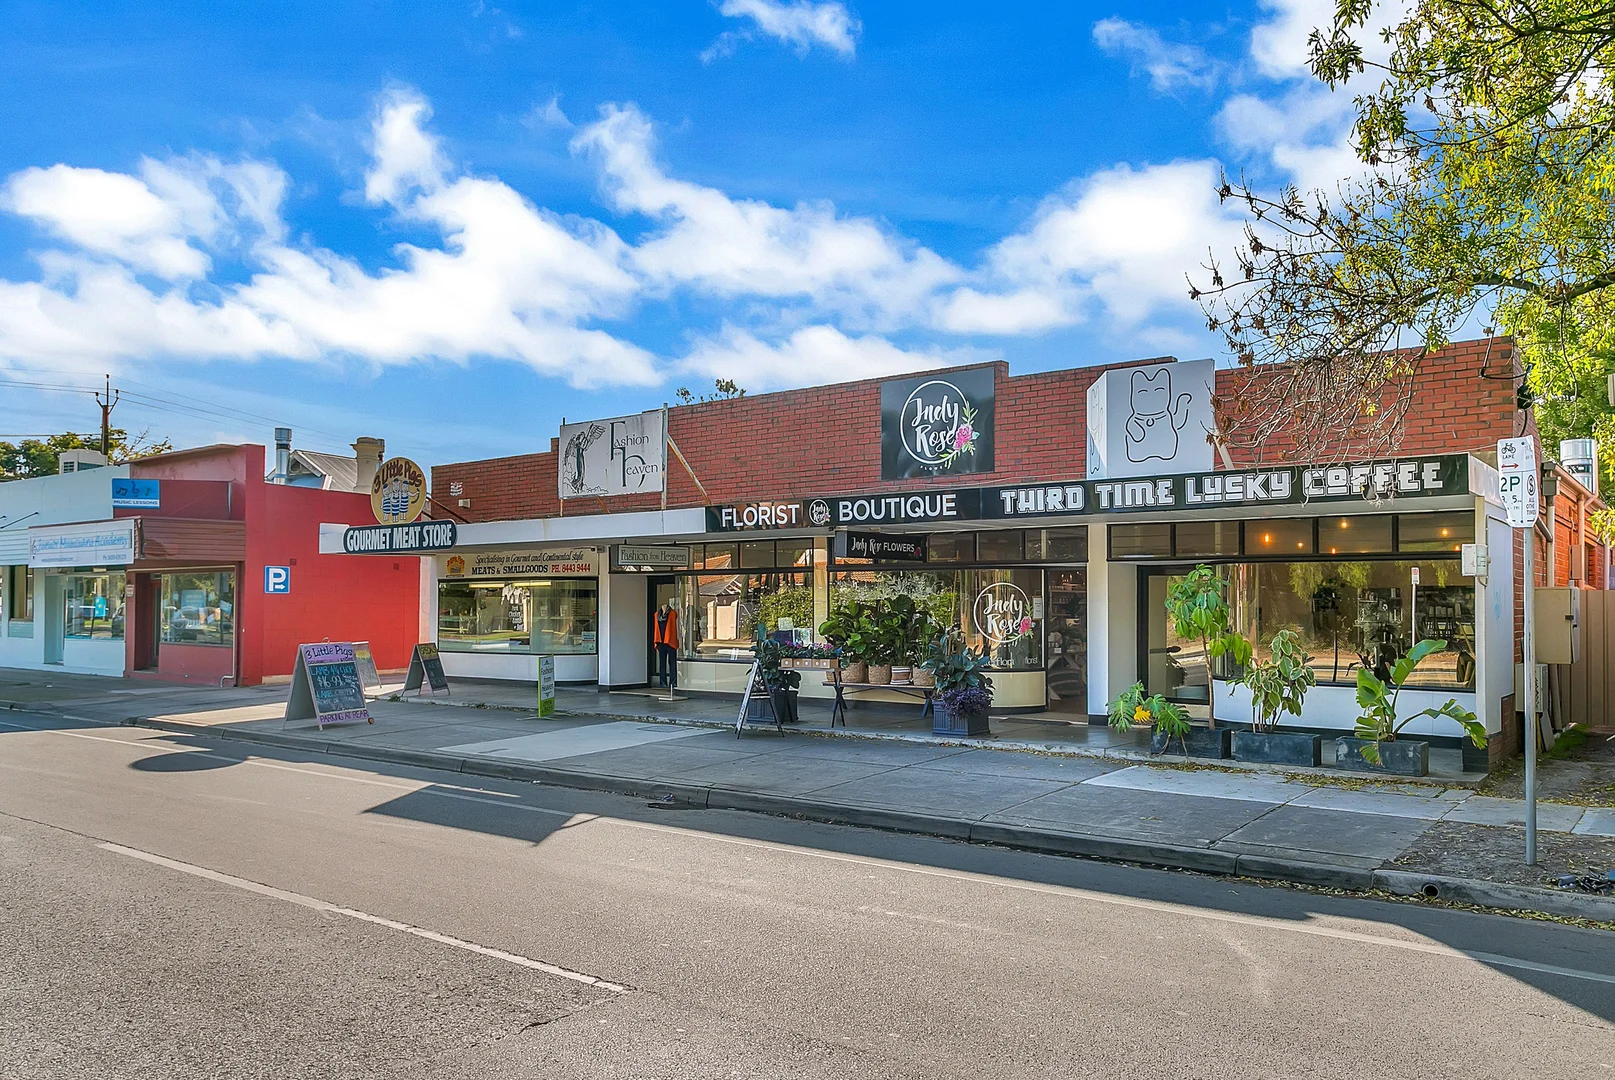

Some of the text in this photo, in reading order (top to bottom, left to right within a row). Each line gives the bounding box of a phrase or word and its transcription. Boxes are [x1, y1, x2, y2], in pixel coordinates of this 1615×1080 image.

[610, 421, 649, 461] Fashion
[915, 424, 955, 458] Rose
[374, 459, 423, 494] 3 Little Pigs
[1000, 461, 1444, 514] THIRD TIME LUCKY COFFEE
[1500, 475, 1521, 492] 2P
[722, 504, 800, 528] FLORIST
[839, 493, 957, 521] BOUTIQUE
[347, 524, 452, 552] GOURMET MEAT STORE
[883, 542, 915, 553] FLOWERS
[511, 553, 531, 565] Gourmet
[543, 551, 573, 562] Continental
[572, 550, 584, 563] style
[621, 549, 649, 561] Fashion
[660, 550, 687, 562] Heaven
[268, 567, 286, 592] P
[472, 566, 496, 575] MEATS
[502, 564, 548, 574] SMALLGOODS
[562, 563, 576, 573] 8443
[576, 563, 591, 573] 9444
[987, 613, 1020, 638] Rose
[305, 649, 312, 660] 3
[312, 645, 333, 658] Little
[334, 645, 353, 659] Pigs
[309, 666, 329, 676] LAMB
[320, 709, 369, 723] PARKING AT REAR
